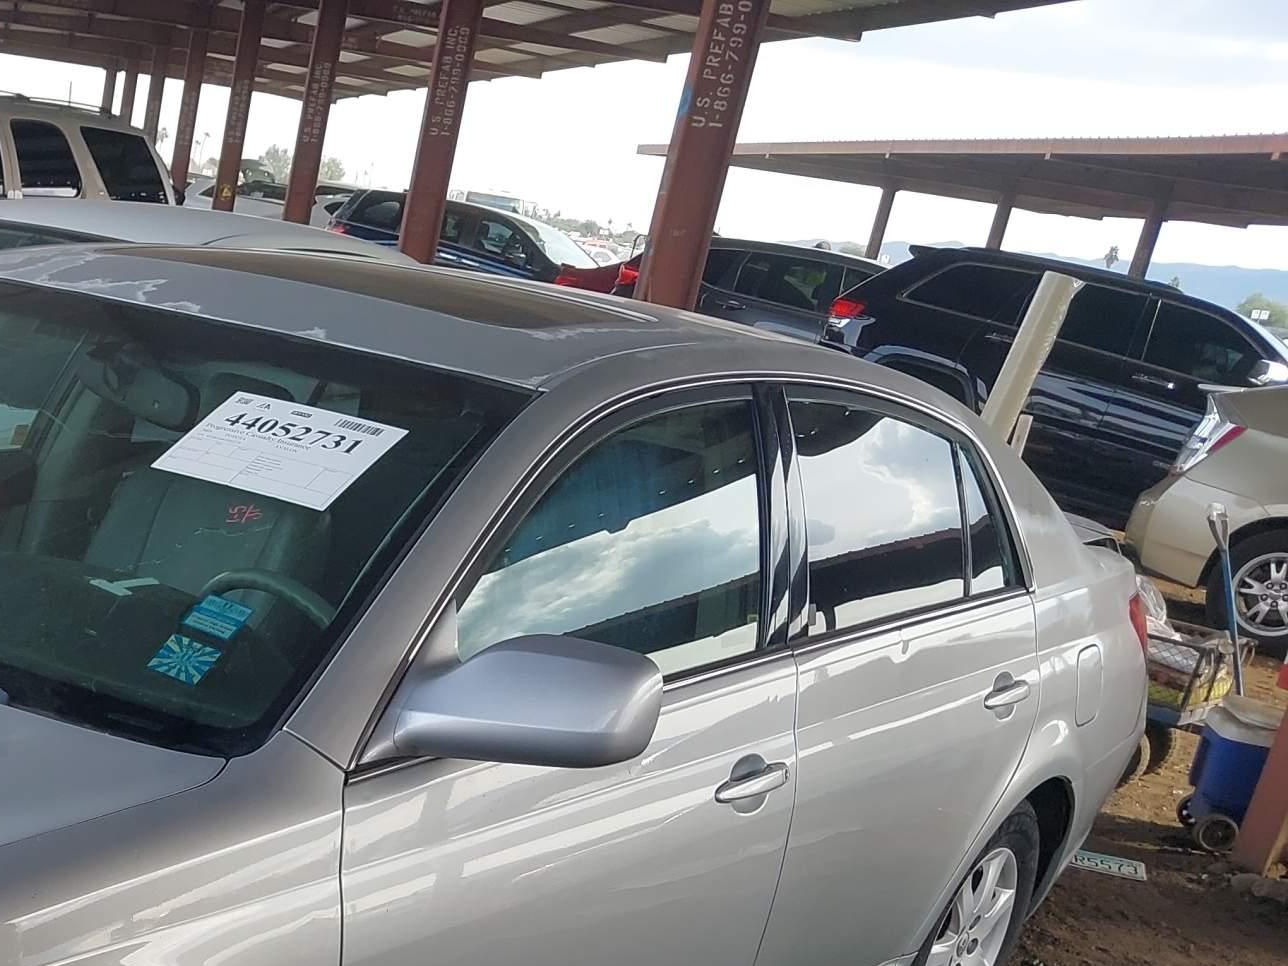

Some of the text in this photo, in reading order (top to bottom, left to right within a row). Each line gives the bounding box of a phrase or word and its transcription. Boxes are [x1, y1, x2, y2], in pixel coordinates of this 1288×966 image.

[703, 3, 734, 80] PREFAB
[224, 412, 363, 454] 44052731
[277, 436, 312, 450] Insurance
